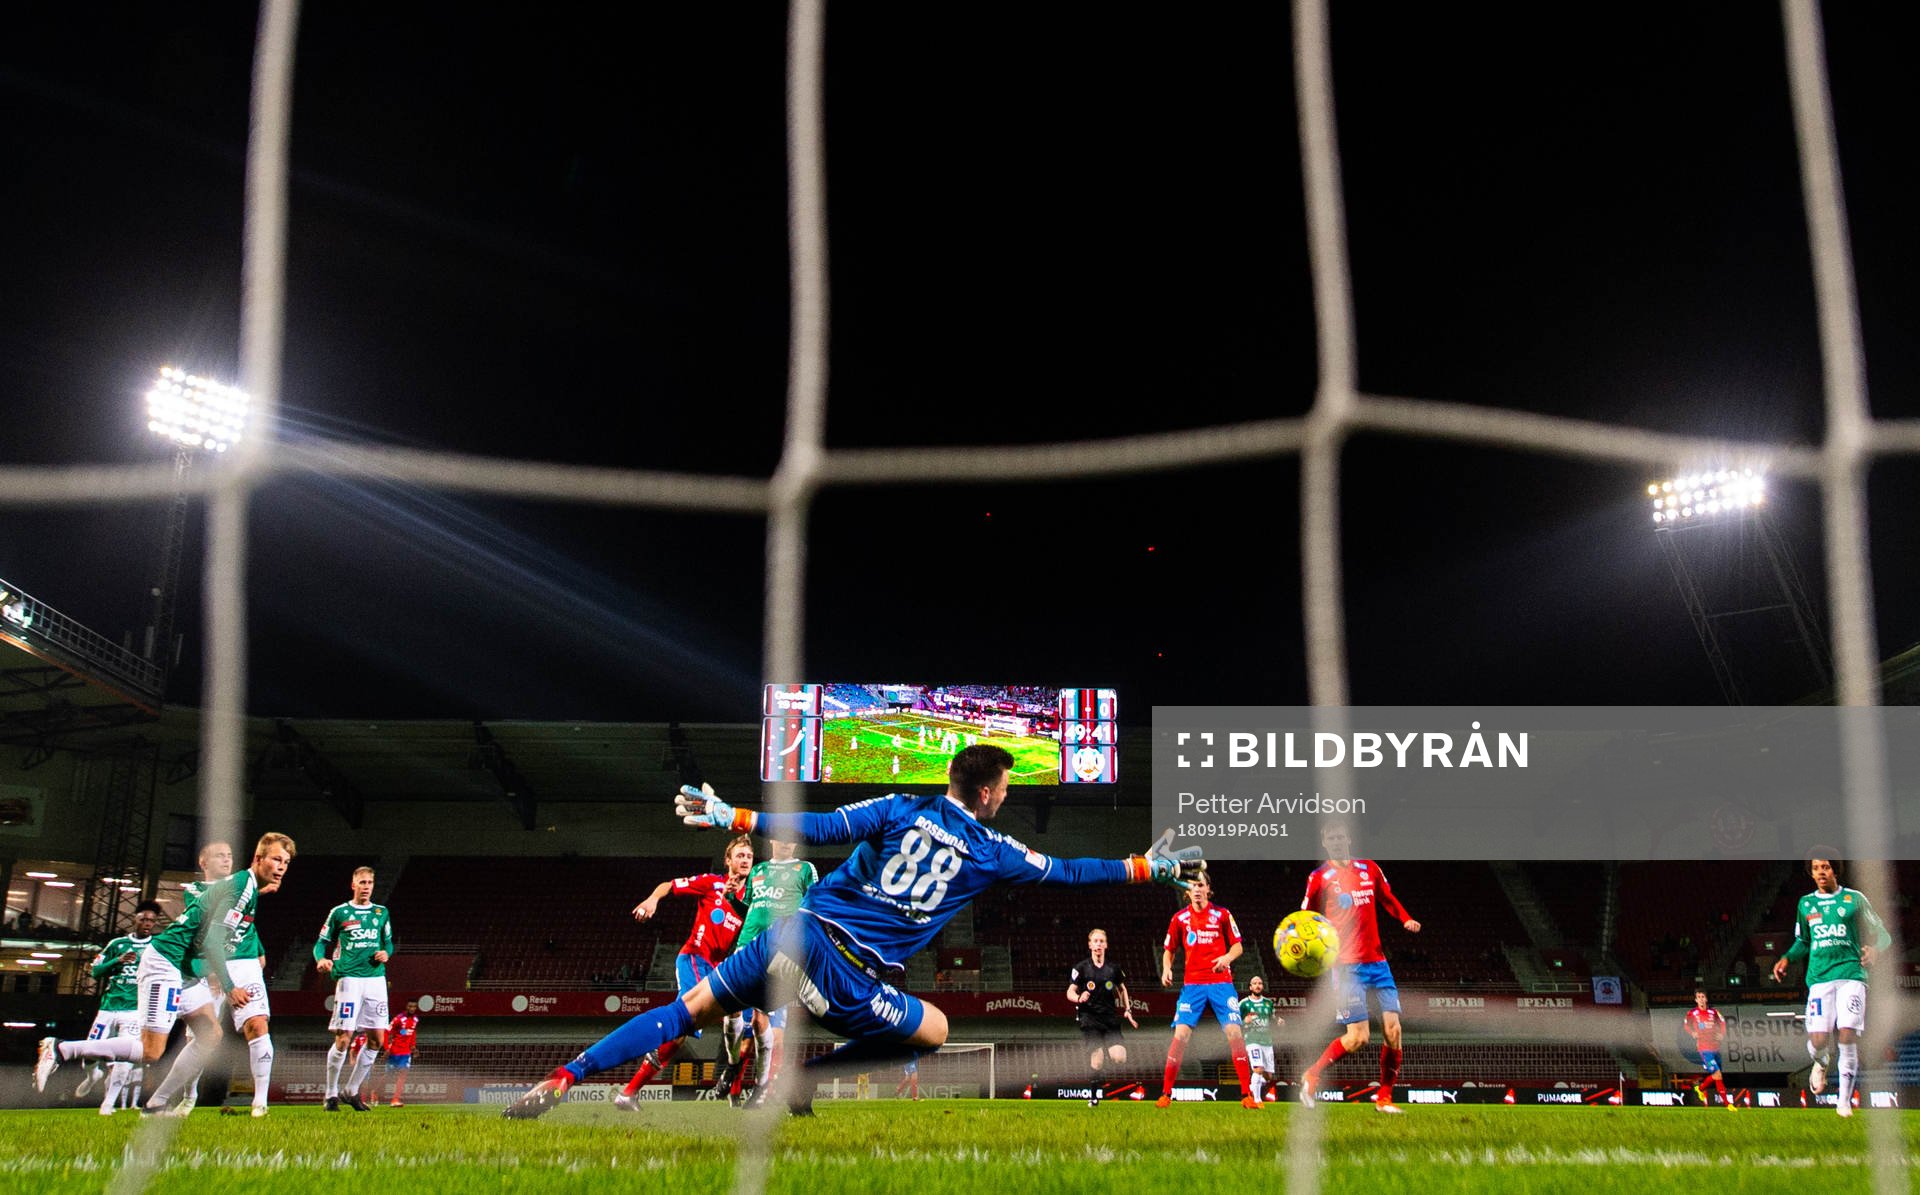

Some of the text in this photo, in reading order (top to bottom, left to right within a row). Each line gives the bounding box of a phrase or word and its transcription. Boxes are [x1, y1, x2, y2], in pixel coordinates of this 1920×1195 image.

[1099, 703, 1109, 717] 0
[1064, 724, 1112, 741] 49:41
[881, 829, 963, 911] 88
[349, 928, 378, 940] SSAB
[1814, 923, 1847, 939] SSAB
[435, 995, 463, 1004] Resurs
[529, 995, 557, 1004] Resurs
[622, 995, 650, 1004] Resurs
[986, 996, 1042, 1013] RAMLÖSA
[1436, 998, 1476, 1008] PEAB
[1525, 998, 1565, 1008] PEAB
[435, 1003, 454, 1012] Bank
[529, 1003, 548, 1012] Bank
[622, 1003, 641, 1012] Bank
[1725, 1015, 1805, 1037] Resurs
[1728, 1041, 1785, 1063] Bank
[569, 1089, 605, 1101] KINGS
[1537, 1093, 1582, 1103] PUMAONE
